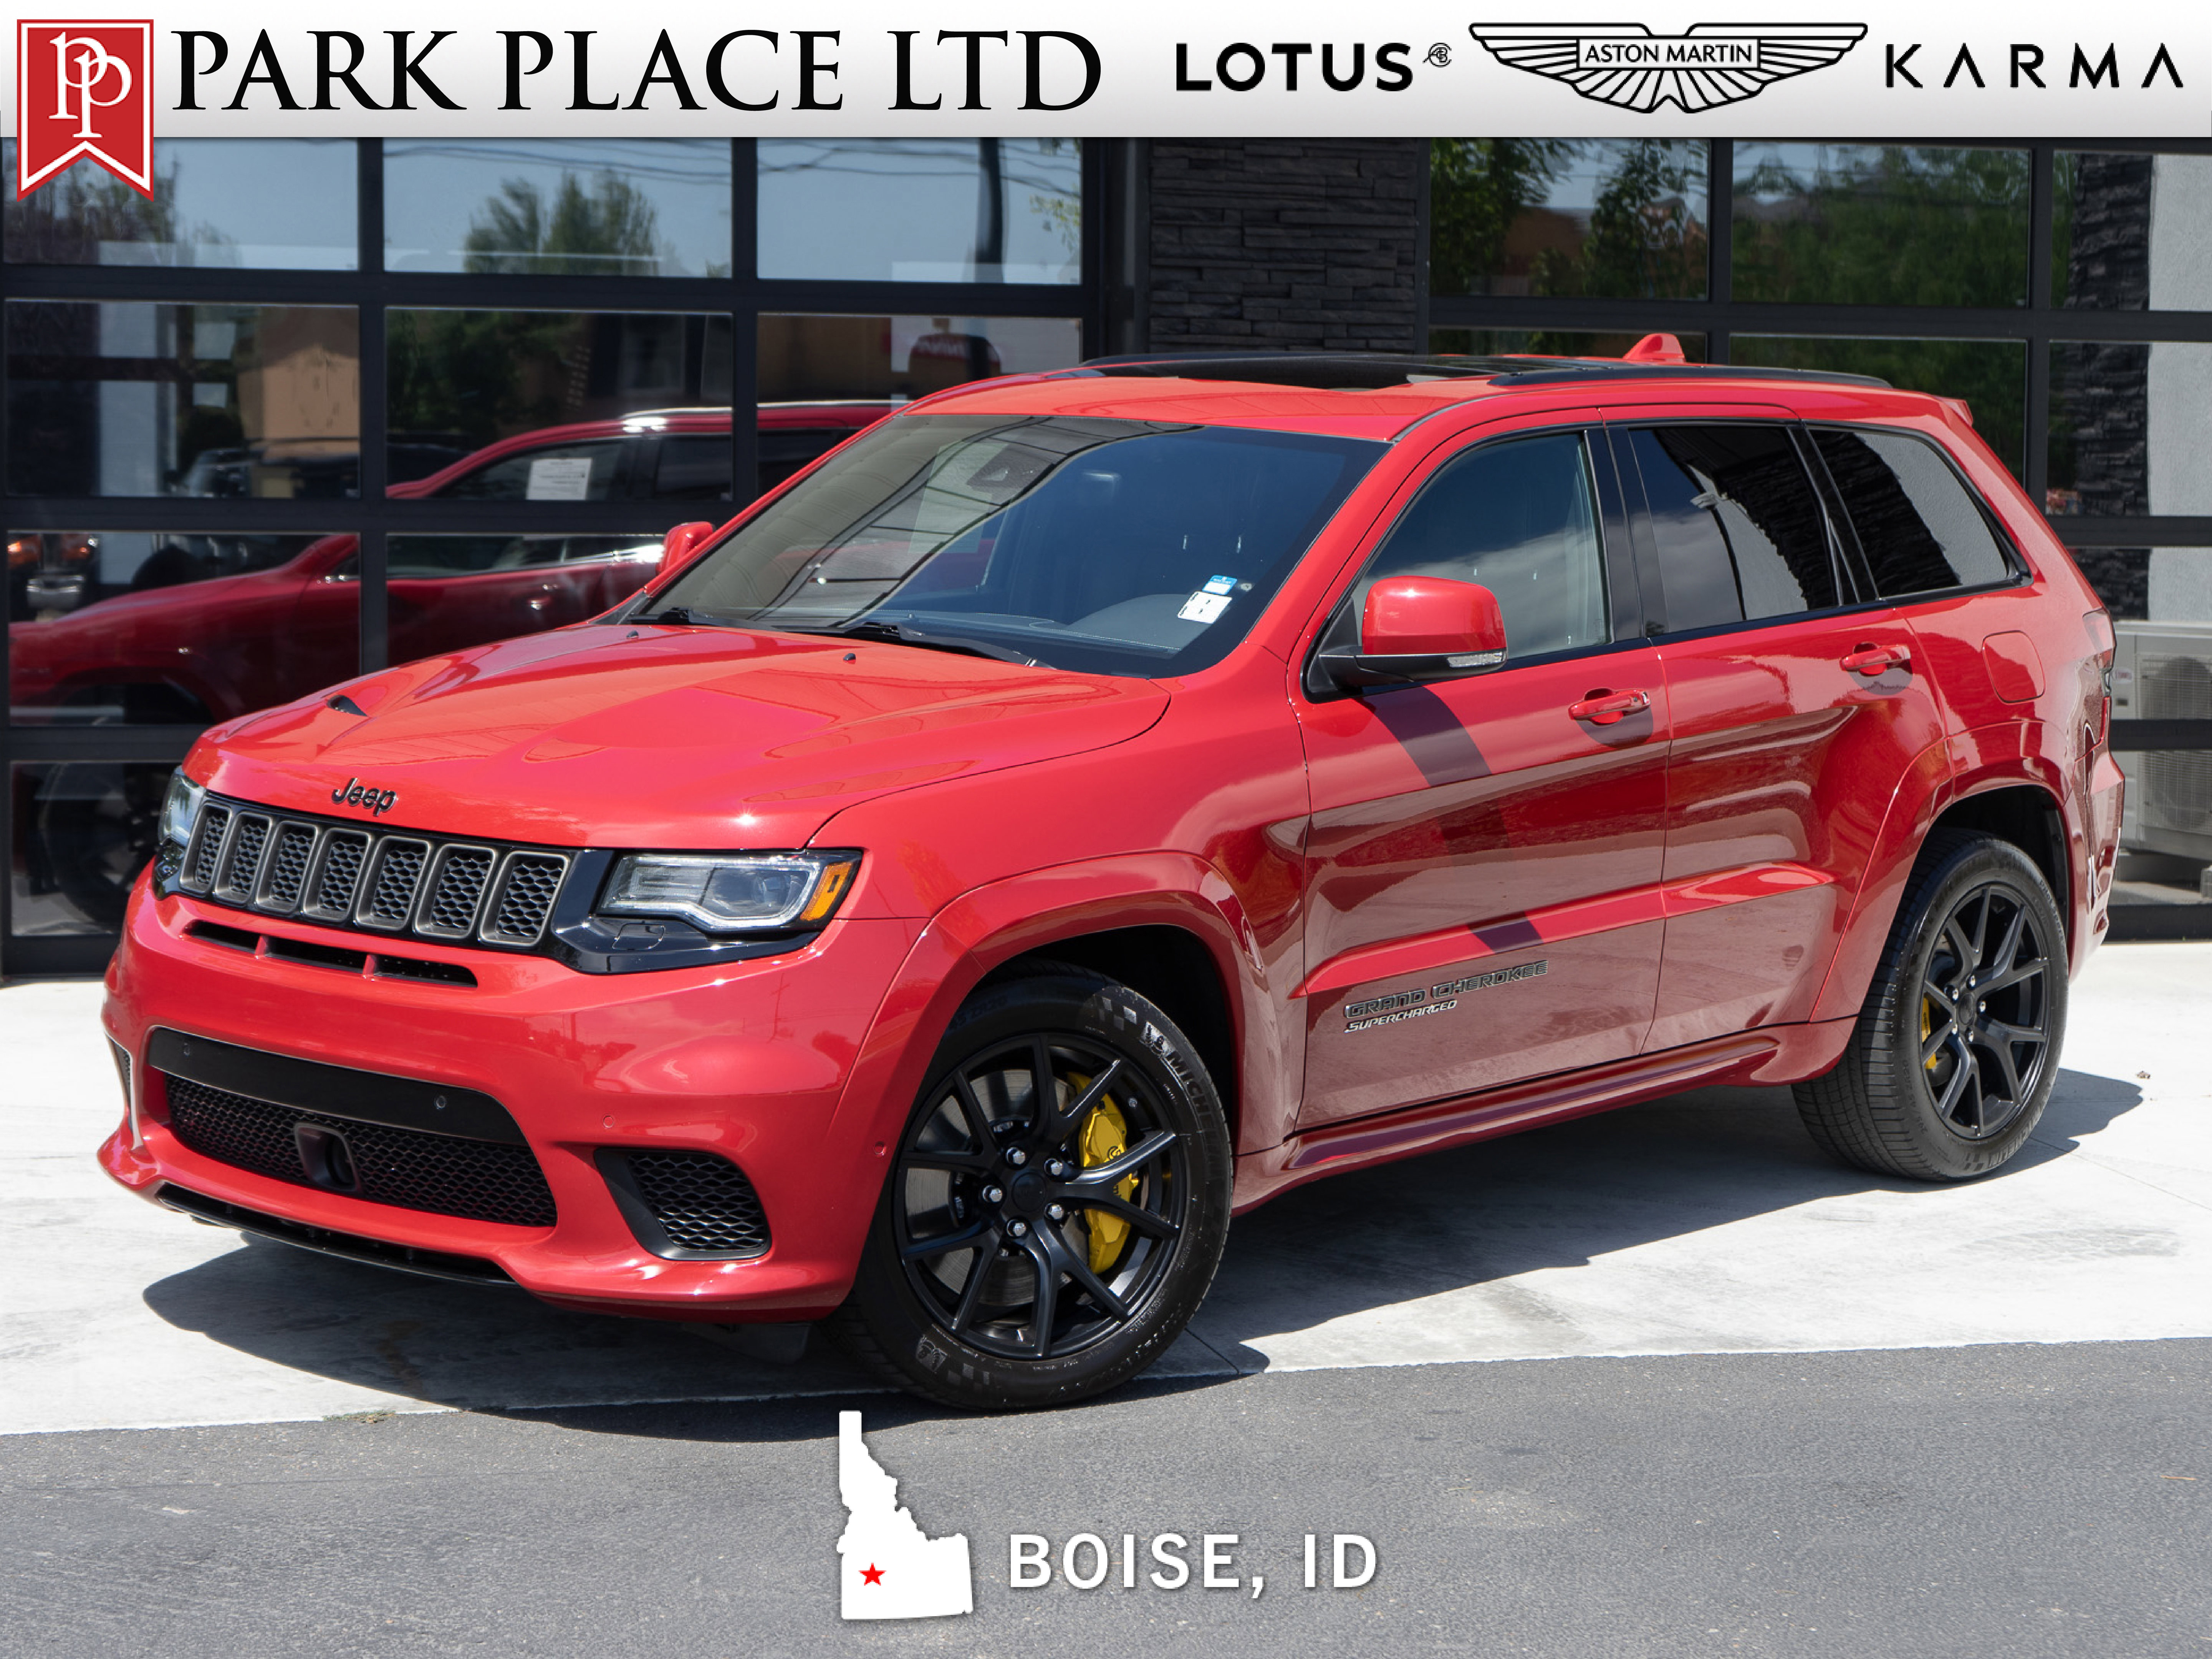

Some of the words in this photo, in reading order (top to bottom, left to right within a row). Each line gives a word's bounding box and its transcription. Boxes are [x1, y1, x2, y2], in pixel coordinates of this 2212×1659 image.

[331, 777, 397, 817] Jeep
[1343, 989, 1426, 1019] GRAND
[1431, 960, 1549, 999] CHEROKEE
[1344, 999, 1458, 1034] SUPERCHARGED
